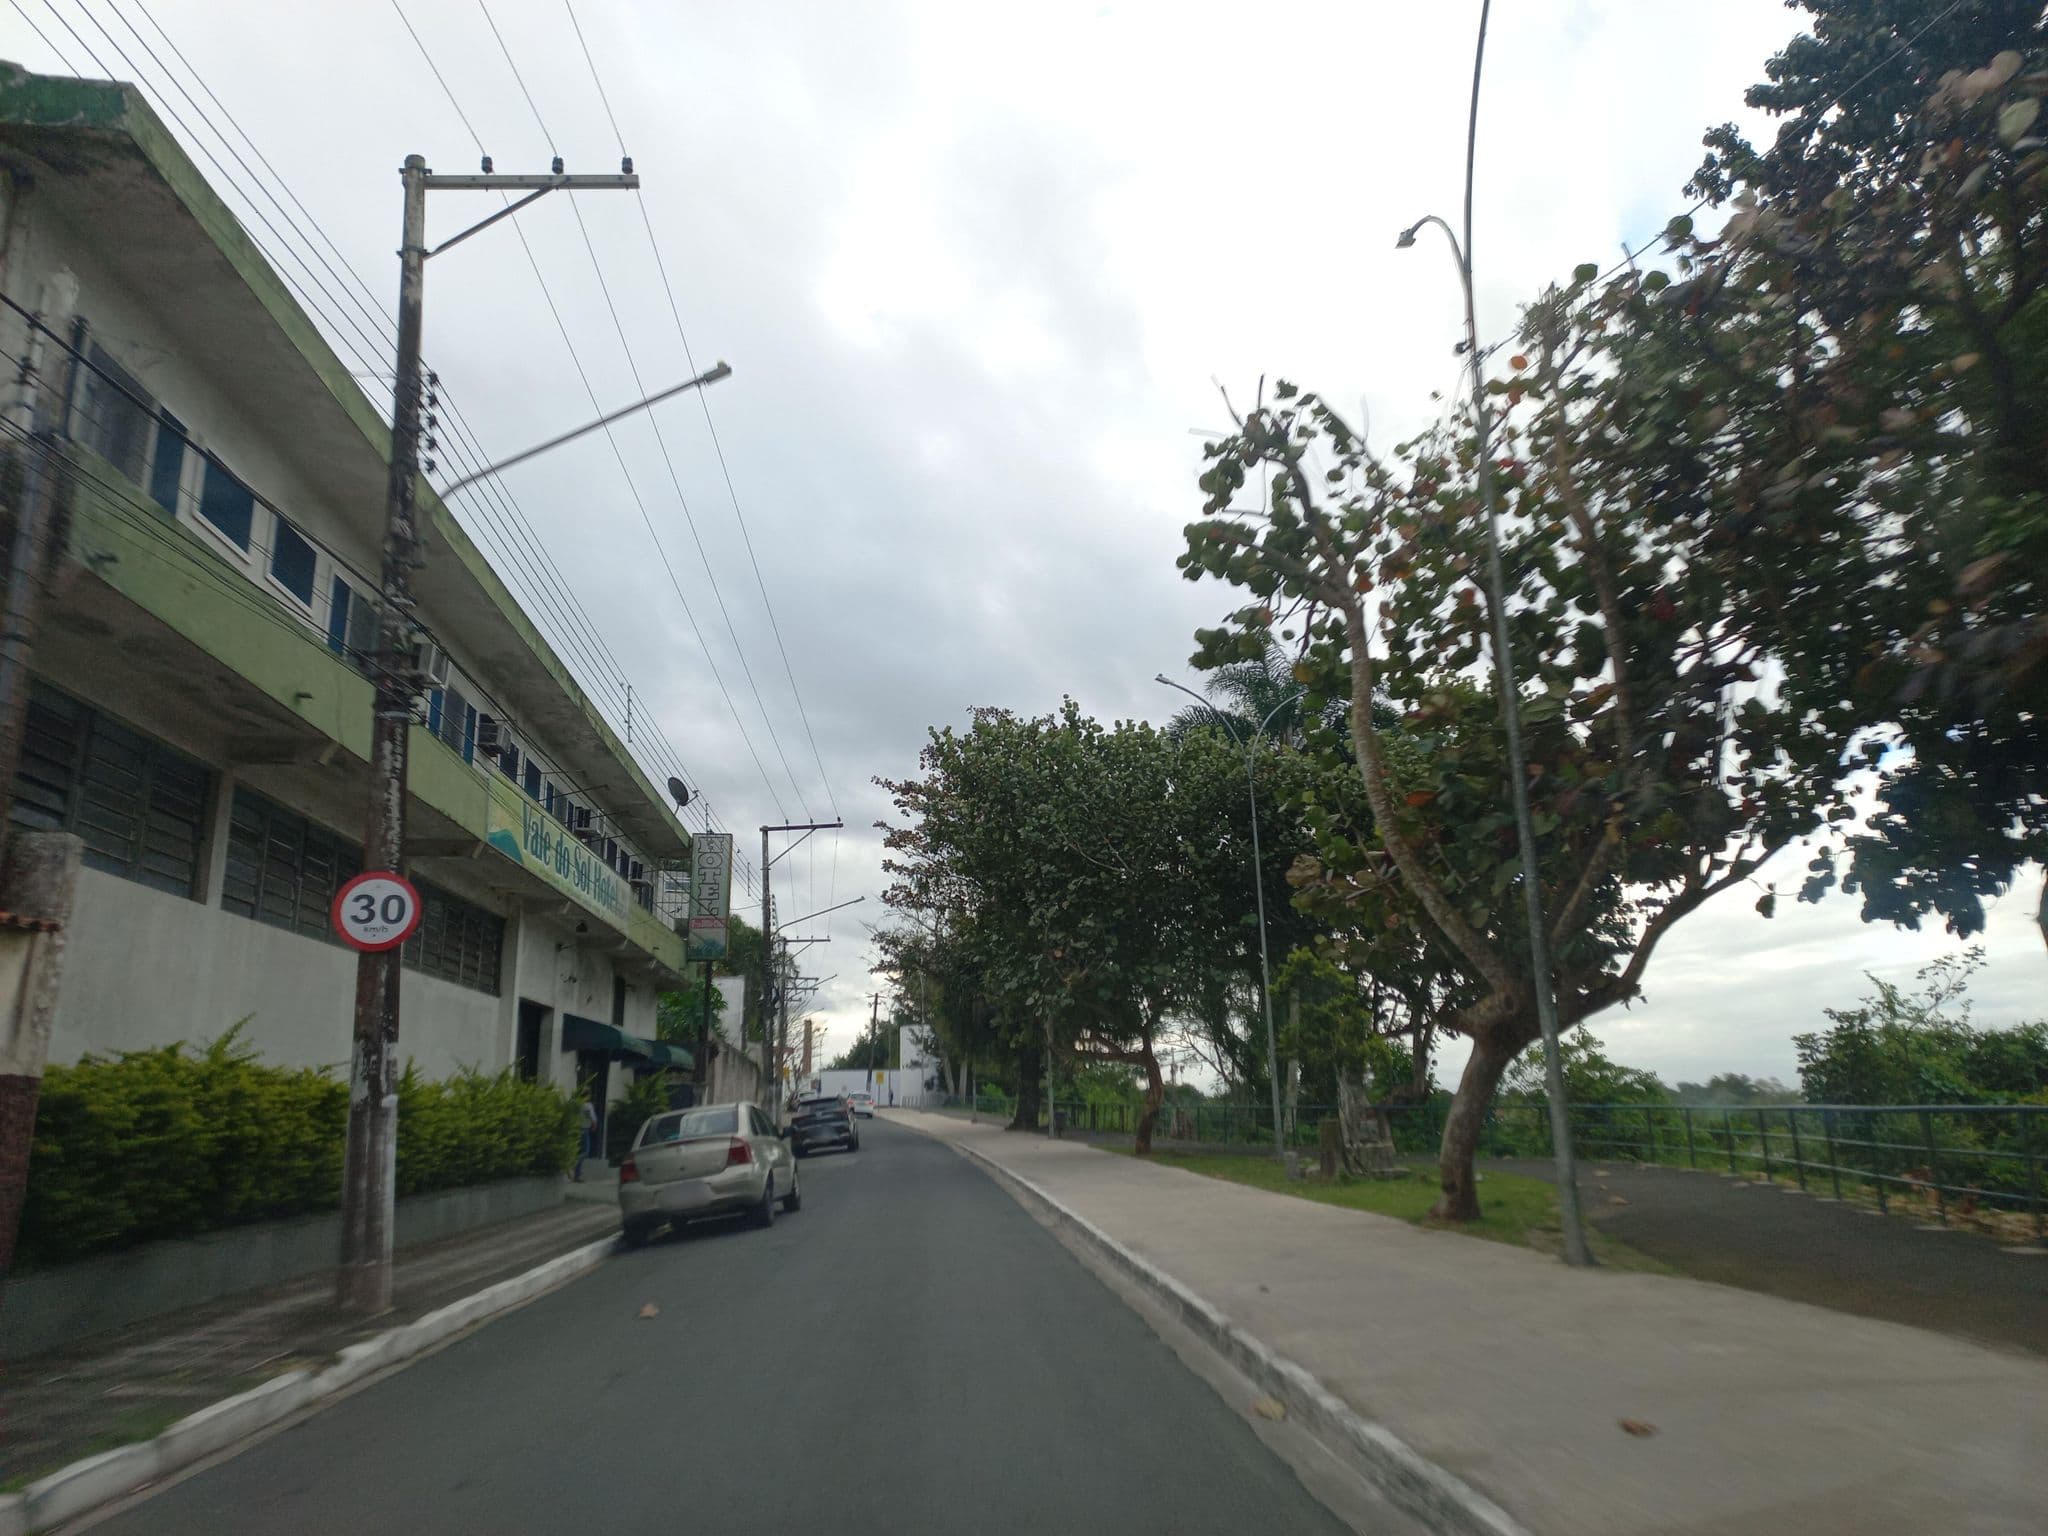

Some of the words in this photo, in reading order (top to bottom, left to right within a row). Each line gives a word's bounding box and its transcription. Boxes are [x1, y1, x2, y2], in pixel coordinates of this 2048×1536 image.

[522, 799, 551, 866] Vale
[555, 831, 570, 880] do
[573, 844, 591, 896] Sol
[593, 862, 618, 912] Hotel
[697, 836, 725, 917] HOTEL
[350, 894, 406, 925] 30
